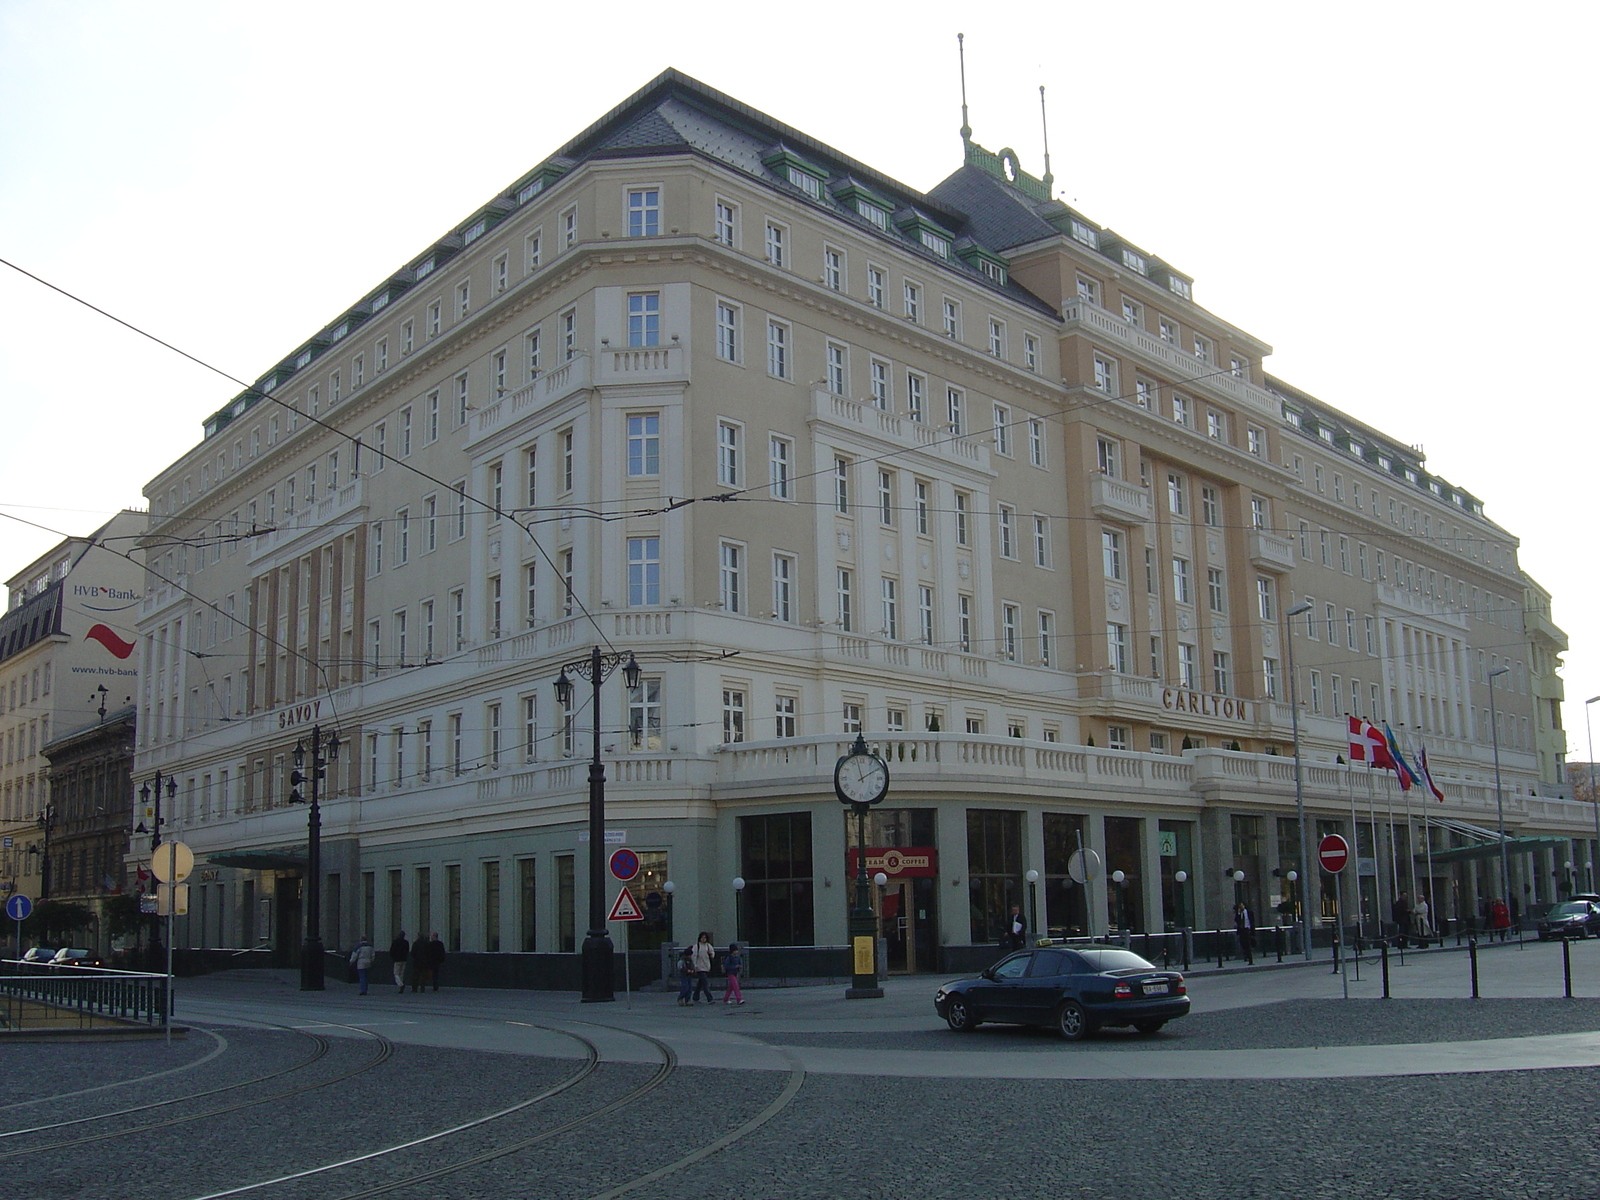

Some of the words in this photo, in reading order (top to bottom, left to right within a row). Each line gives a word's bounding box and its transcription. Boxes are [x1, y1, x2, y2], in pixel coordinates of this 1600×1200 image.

[73, 585, 99, 597] HVB
[108, 588, 137, 600] Bank
[279, 700, 321, 729] SAVOY
[1162, 687, 1247, 721] CARLTON
